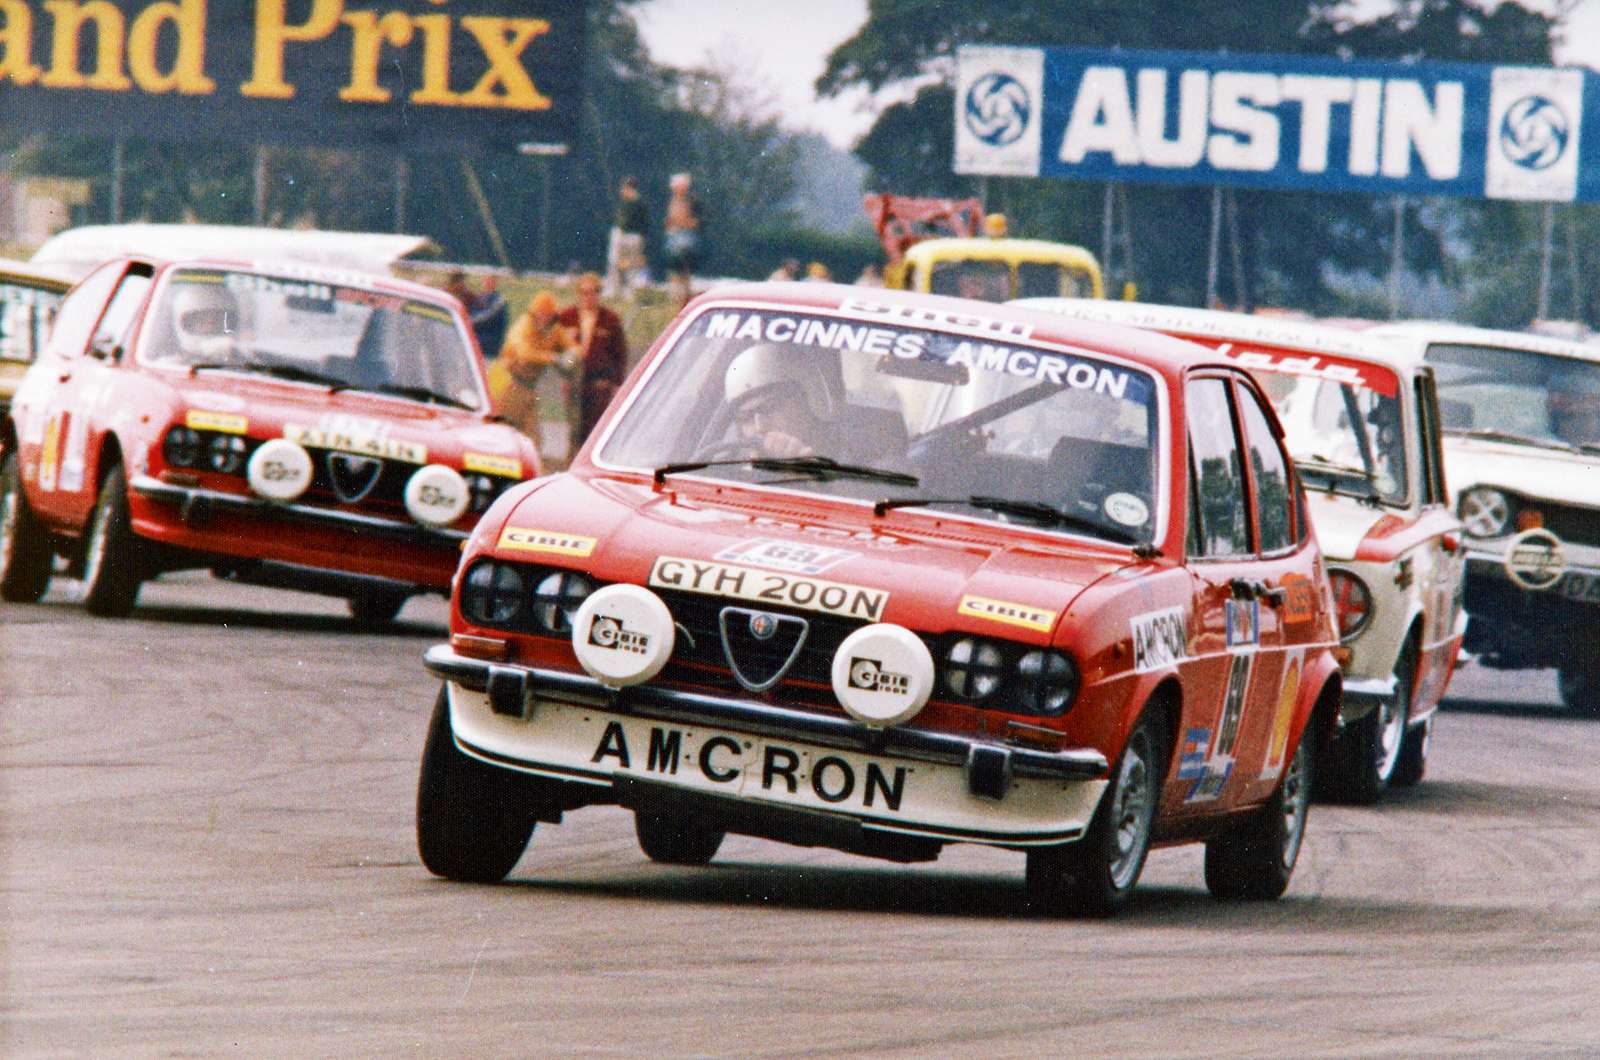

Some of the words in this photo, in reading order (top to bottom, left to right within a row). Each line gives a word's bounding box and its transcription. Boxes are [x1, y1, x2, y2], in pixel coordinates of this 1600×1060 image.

[240, 0, 552, 110] Prix
[1058, 64, 1465, 180] AUSTIN
[705, 313, 925, 359] MACINNES
[946, 341, 1129, 399] AMCRON
[507, 533, 590, 551] CIBIE
[657, 560, 747, 594] GYH
[757, 576, 883, 618] 200N
[966, 601, 1047, 625] CIBIE
[590, 720, 906, 812] AMCRON
